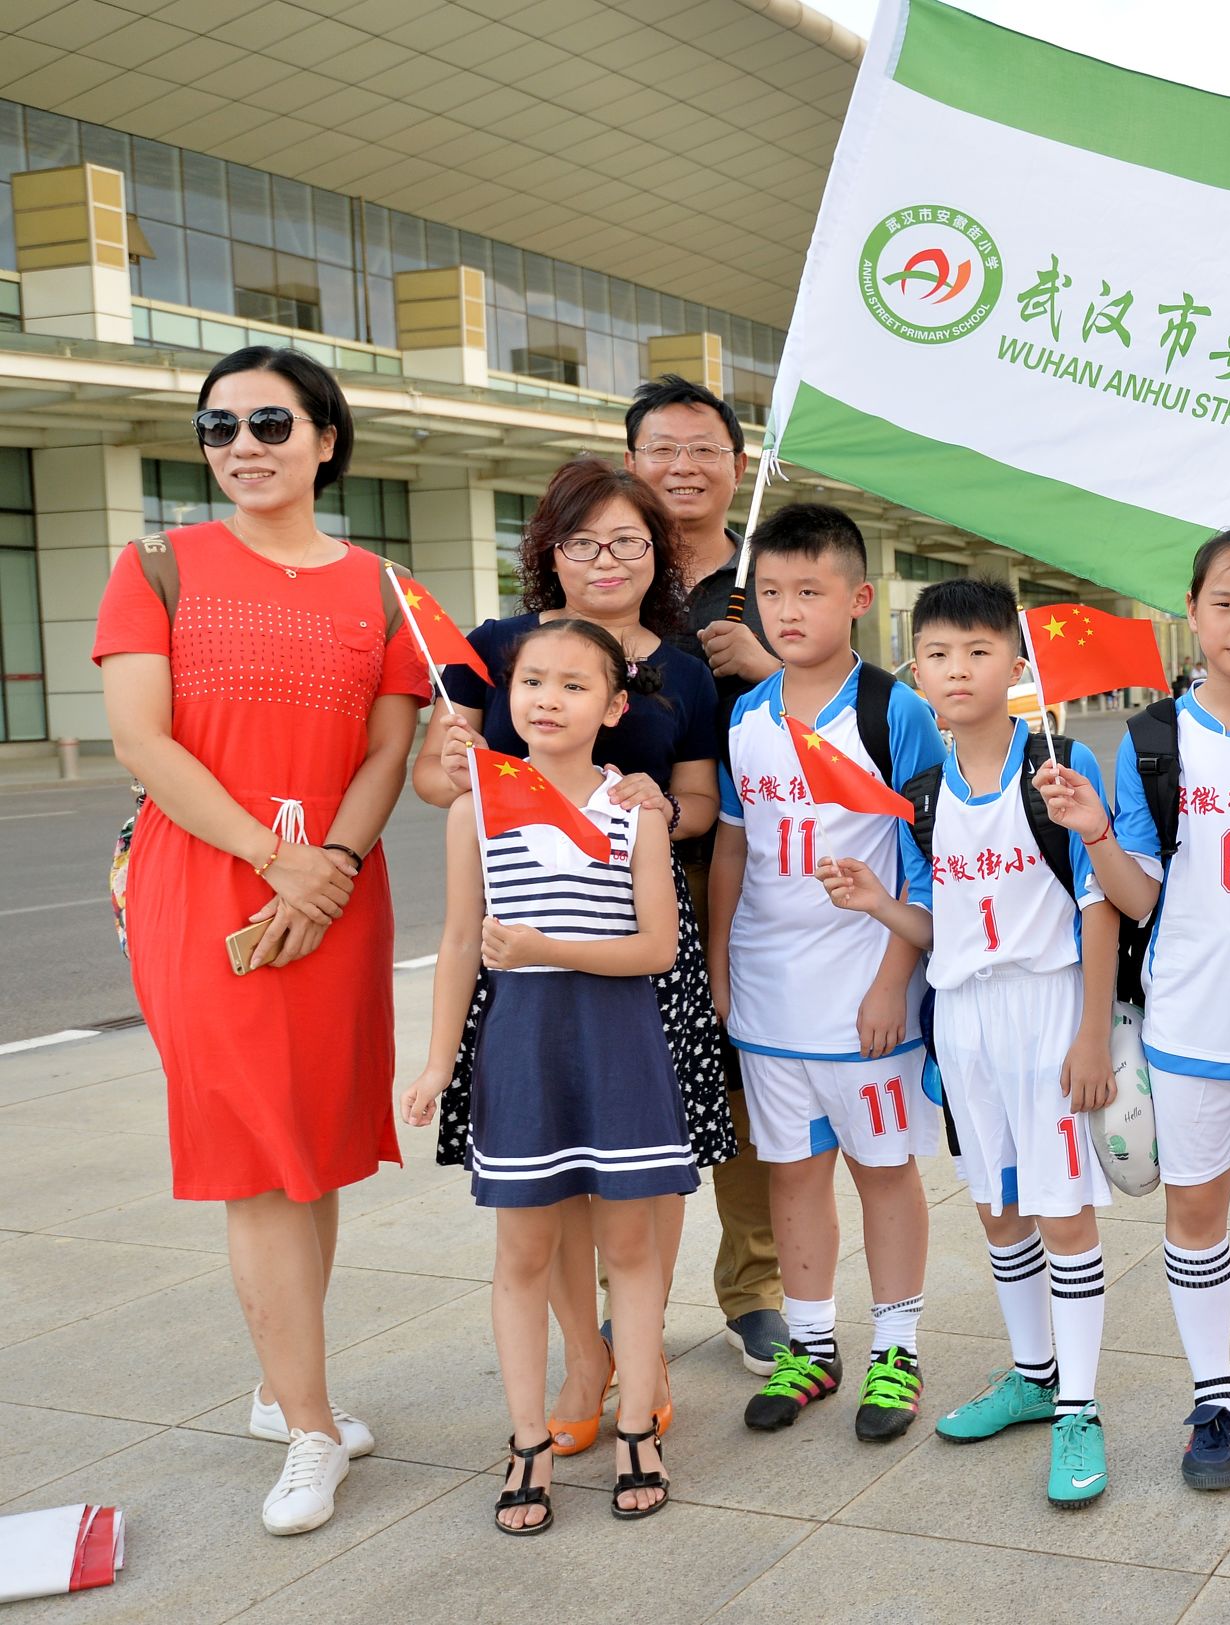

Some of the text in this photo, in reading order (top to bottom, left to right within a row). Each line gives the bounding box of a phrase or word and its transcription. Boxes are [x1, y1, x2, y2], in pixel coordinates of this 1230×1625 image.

[885, 207, 999, 270] 武汉市安徽街小学
[863, 259, 990, 341] ANHUI STREET PRIMARY SCHOOL
[997, 334, 1103, 389] WUHAN
[1102, 369, 1191, 414] ANHUI
[777, 817, 817, 876] 11
[932, 847, 1048, 886] 安徽街小
[979, 896, 1001, 952] 1
[859, 1075, 909, 1136] 11
[1124, 1106, 1142, 1123] Hello
[1057, 1116, 1081, 1180] 1
